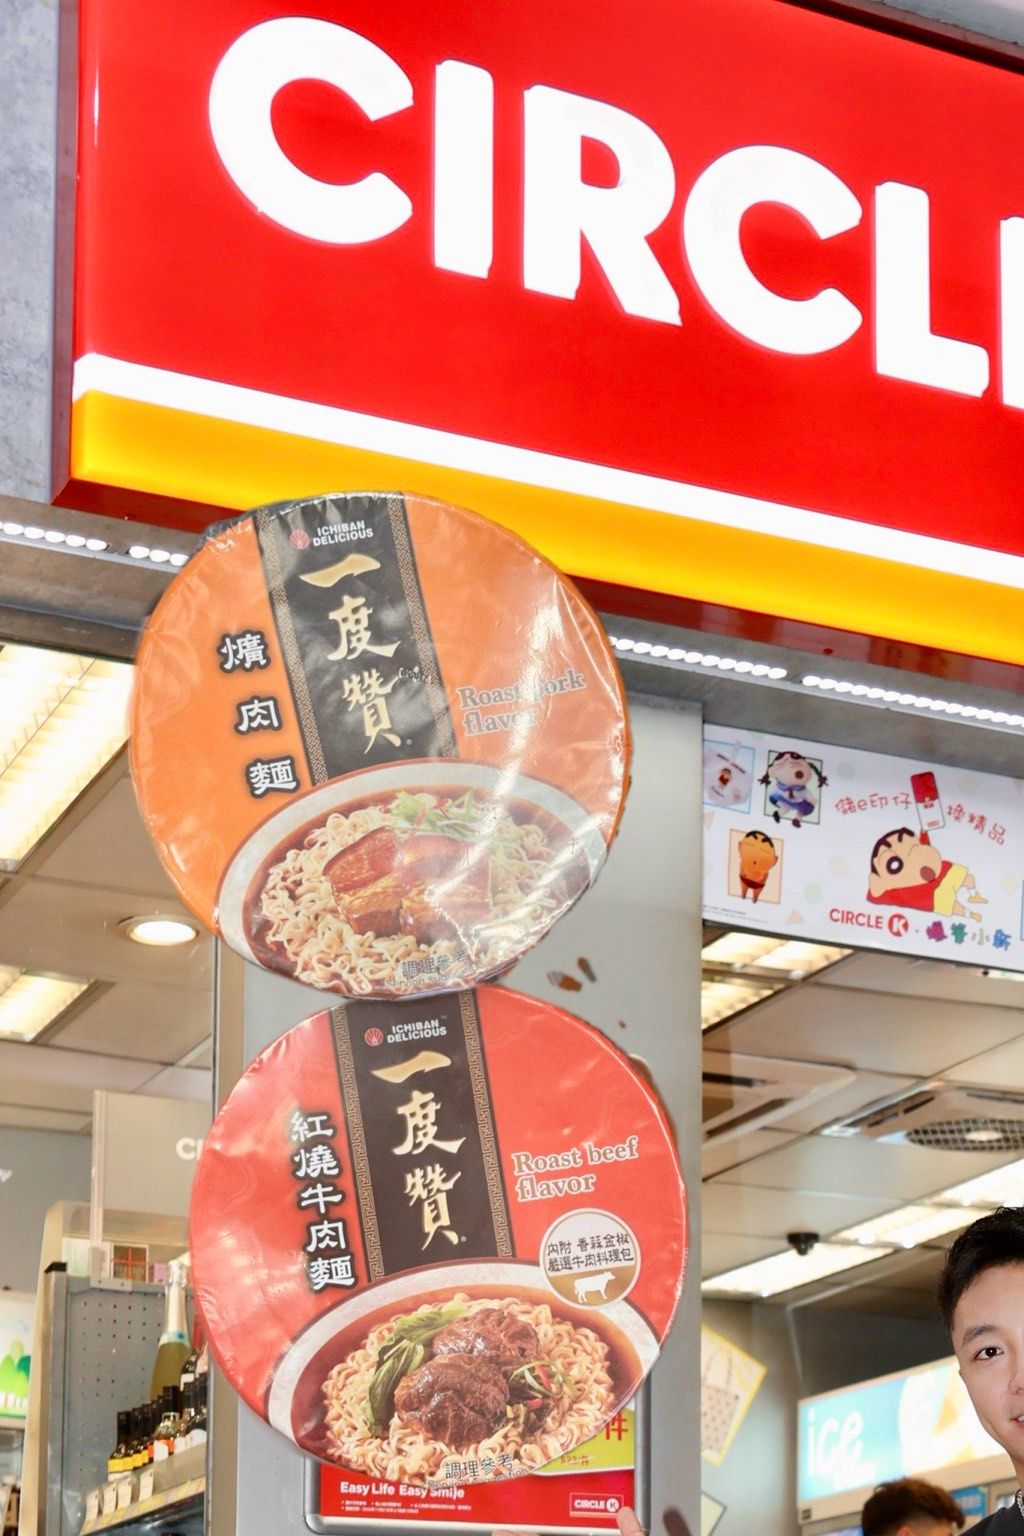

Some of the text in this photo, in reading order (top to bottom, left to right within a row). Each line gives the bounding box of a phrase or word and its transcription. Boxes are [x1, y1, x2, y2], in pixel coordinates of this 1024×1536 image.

[312, 527, 374, 548] DELICIOUS
[316, 520, 366, 538] ICHIBAN
[457, 683, 523, 709] Roast
[829, 908, 909, 937] CIRCLE K
[387, 1025, 448, 1044] DELICIOUS
[392, 1019, 440, 1034] ICHIBAN
[512, 1136, 639, 1175] Roast beef
[515, 1174, 596, 1202] flavor
[289, 1111, 355, 1291] 紅燒牛肉麵
[340, 1481, 370, 1497] Easy
[371, 1482, 395, 1496] Life
[399, 1484, 428, 1499] Easy
[574, 1498, 619, 1512] CIRCLE K
